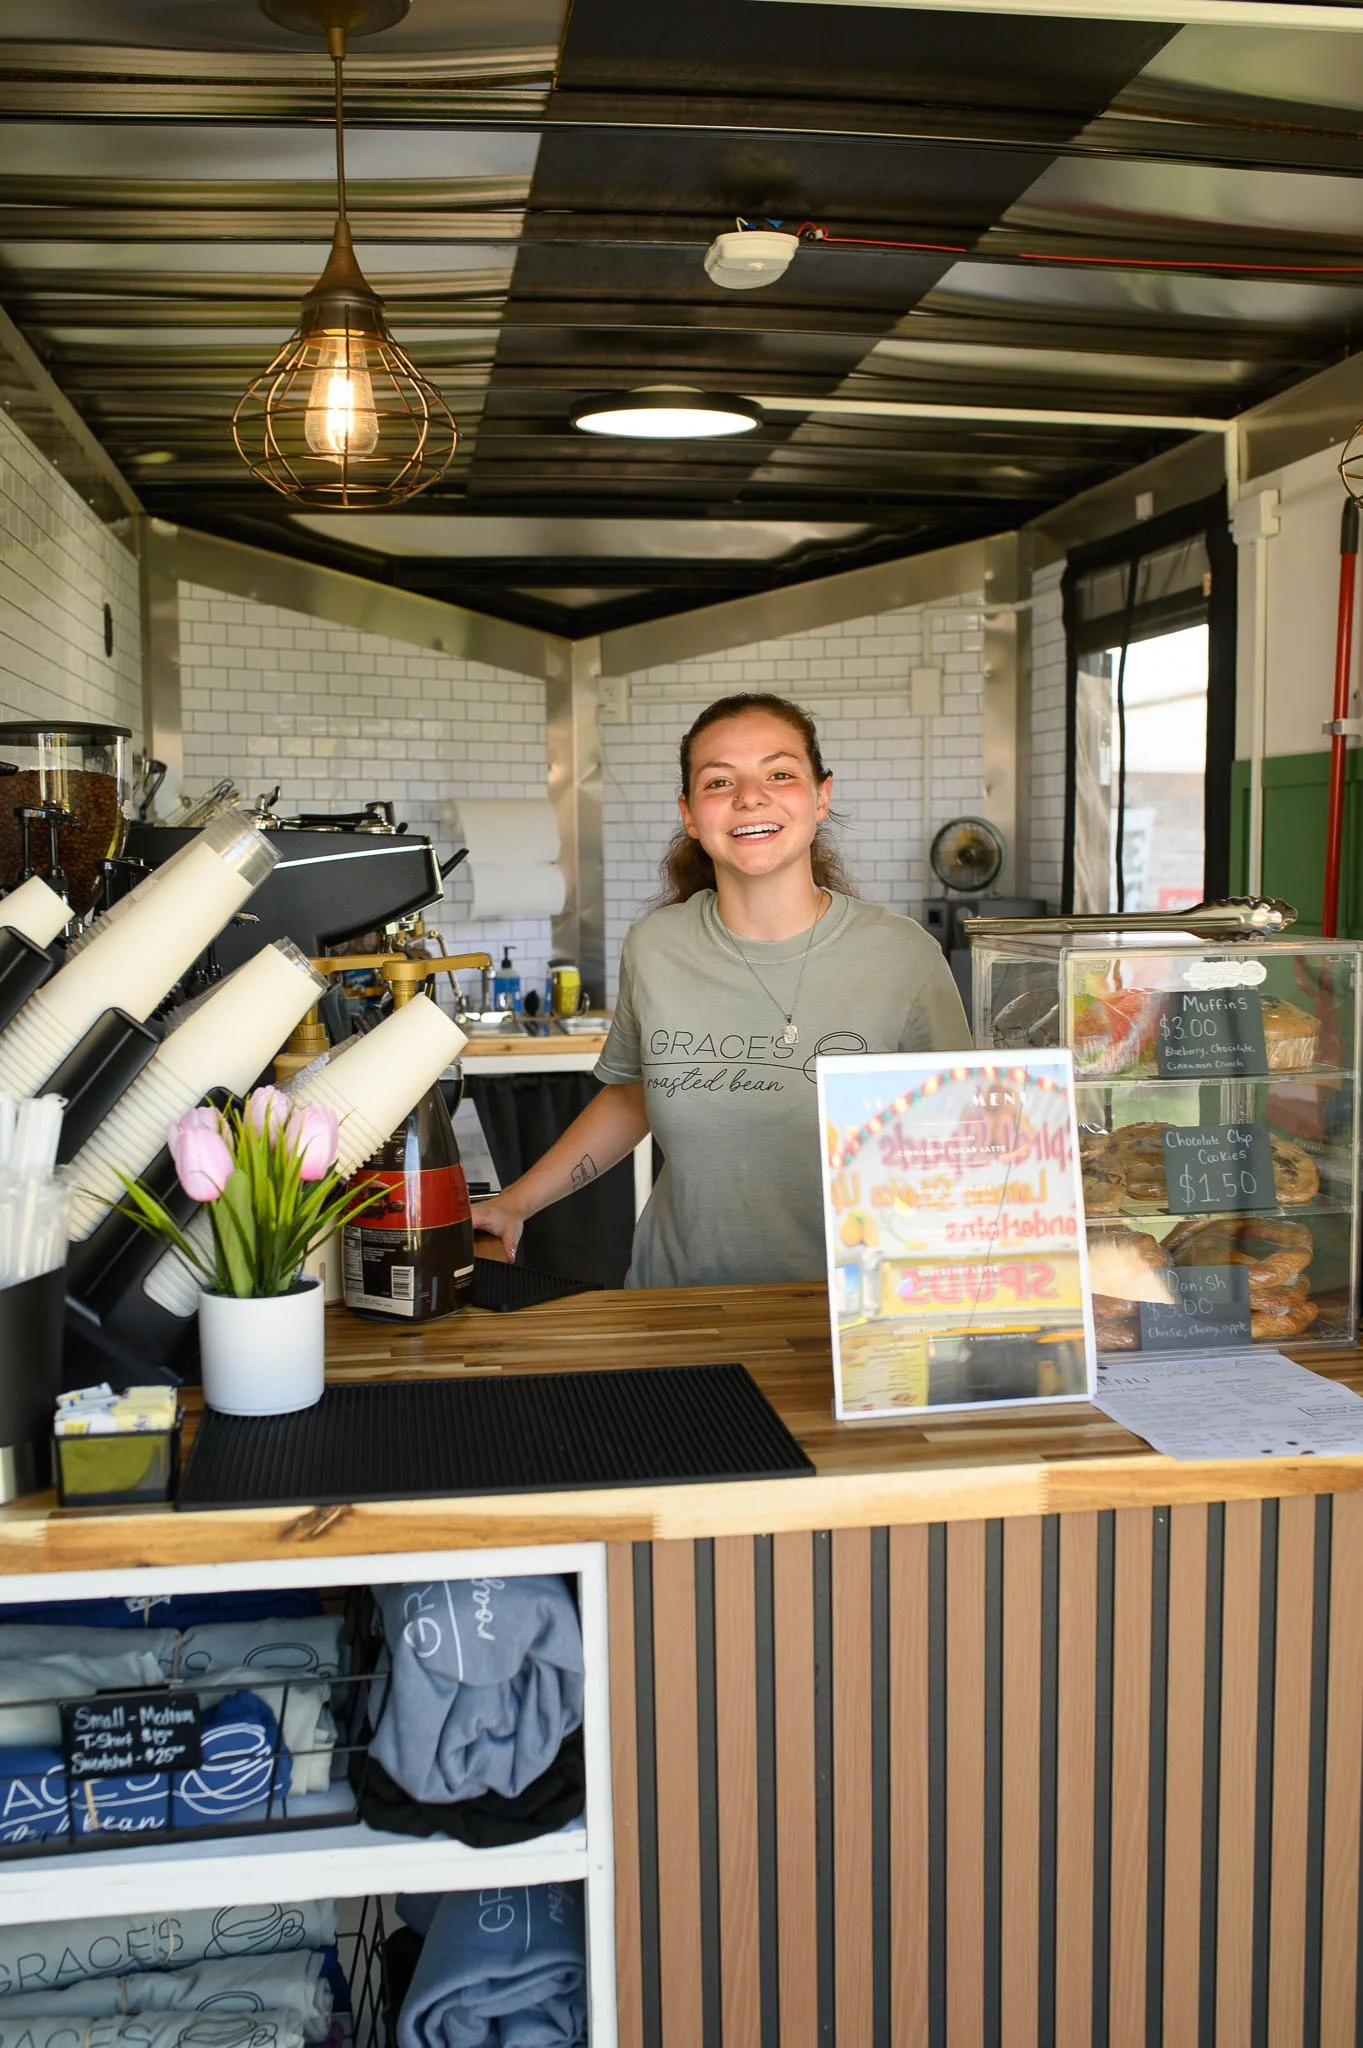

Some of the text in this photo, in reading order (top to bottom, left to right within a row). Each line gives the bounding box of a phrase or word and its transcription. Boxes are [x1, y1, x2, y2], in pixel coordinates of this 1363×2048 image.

[1159, 1013, 1217, 1041] $3.00
[650, 1029, 795, 1059] GRACE'S
[646, 1067, 786, 1098] roasted bean
[1165, 1128, 1253, 1149] Chocolate Chip
[1197, 1149, 1248, 1165] Cookies
[1179, 1163, 1257, 1208] $1.50
[1166, 1269, 1227, 1293] Danish
[73, 1706, 125, 1730] Small
